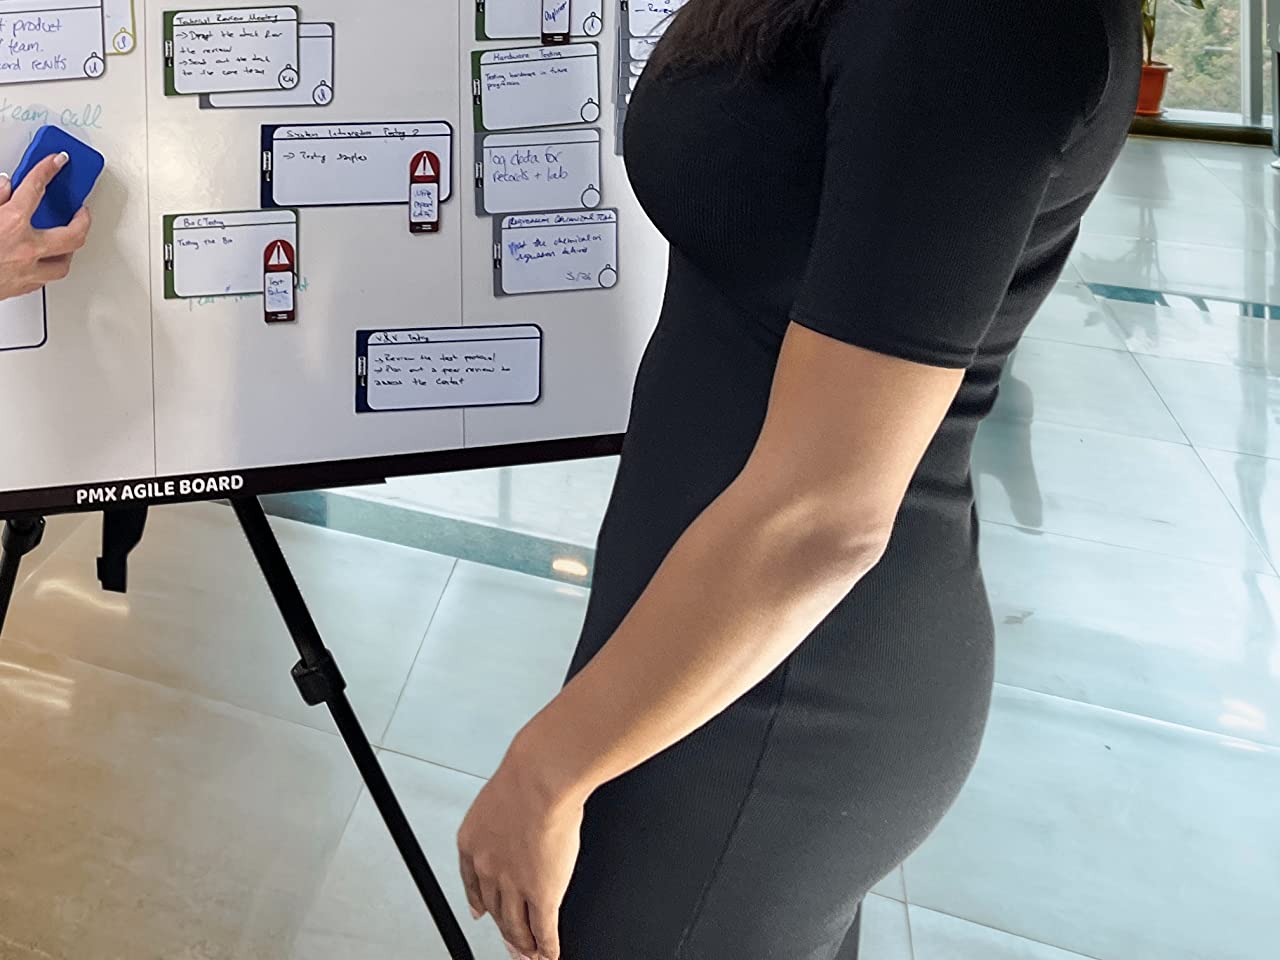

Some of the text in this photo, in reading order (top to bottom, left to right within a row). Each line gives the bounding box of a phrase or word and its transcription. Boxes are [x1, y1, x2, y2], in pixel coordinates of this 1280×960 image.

[12, 17, 63, 37] product
[60, 103, 104, 129] call
[510, 149, 540, 165] data
[76, 474, 244, 505] PMX AGILE BOARD
